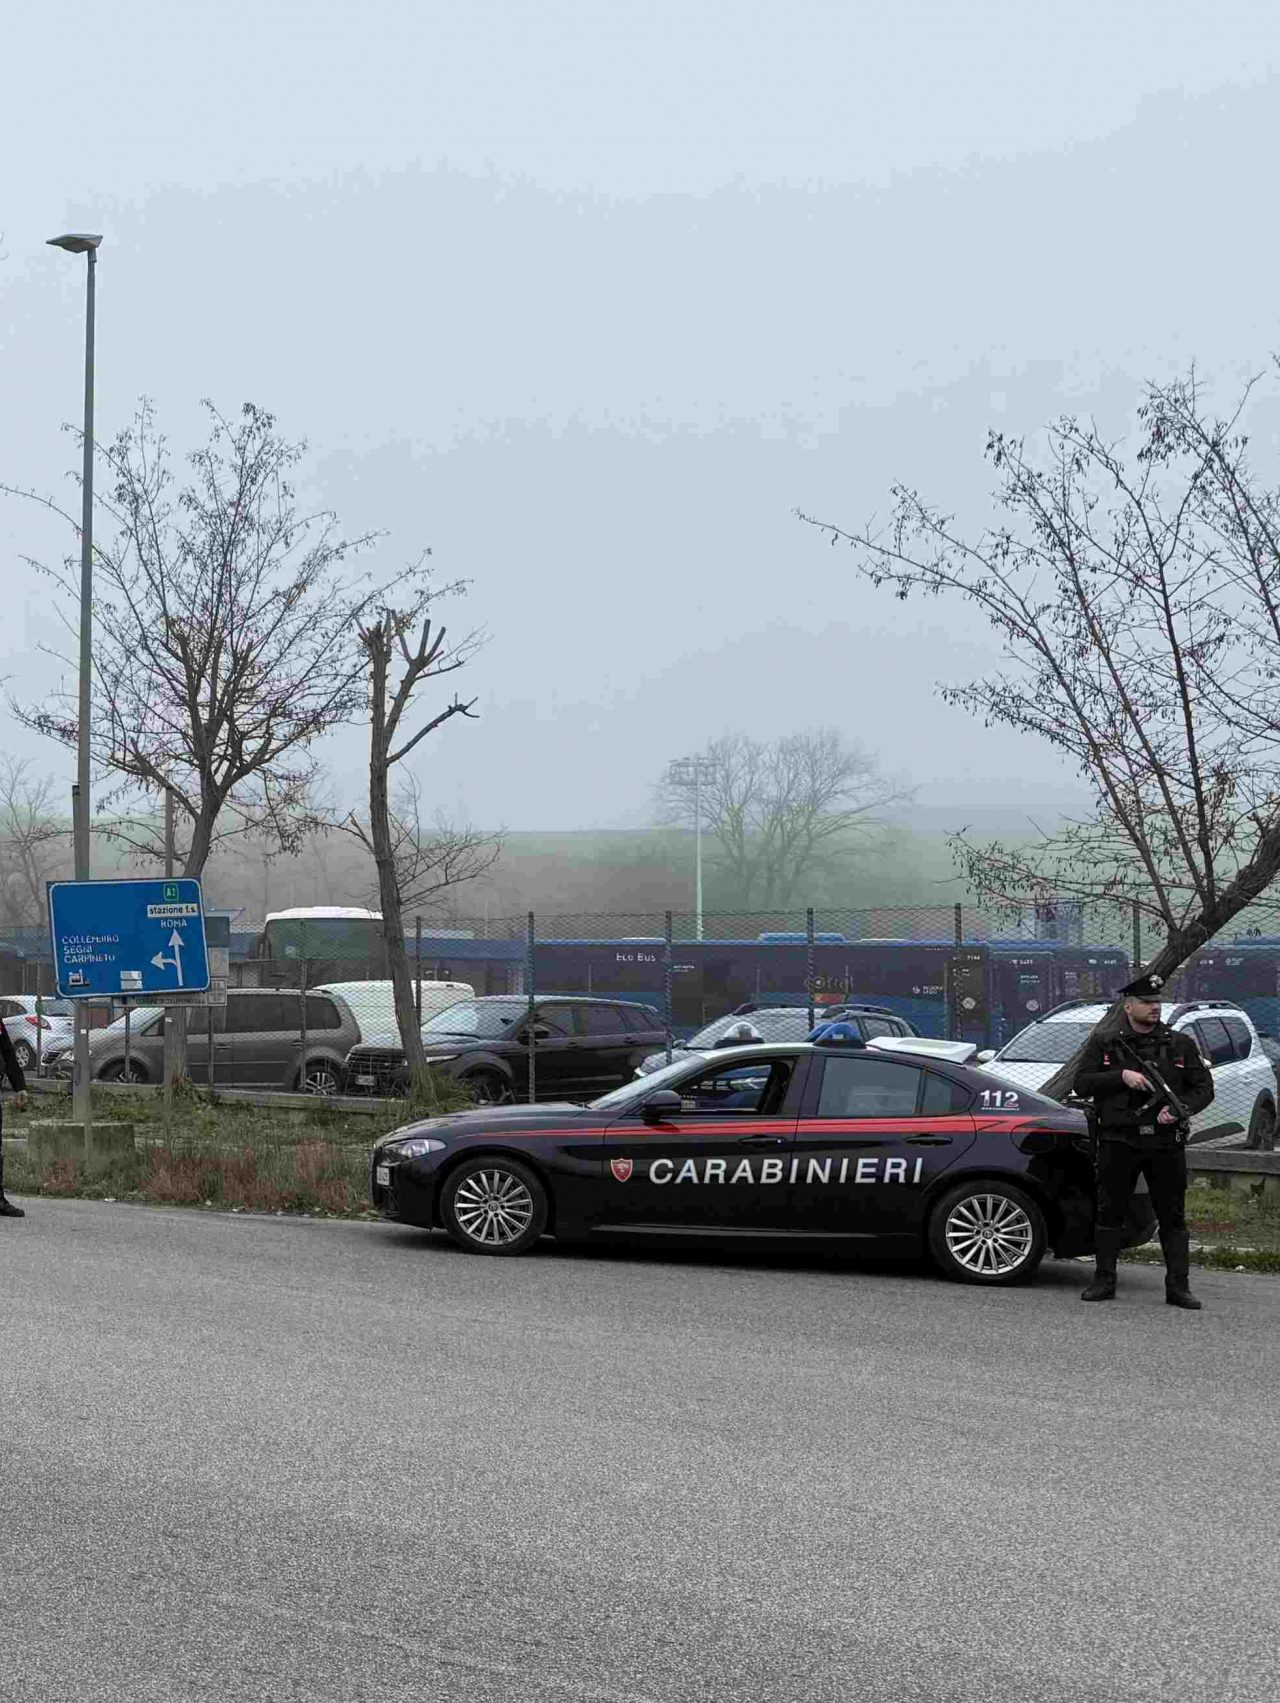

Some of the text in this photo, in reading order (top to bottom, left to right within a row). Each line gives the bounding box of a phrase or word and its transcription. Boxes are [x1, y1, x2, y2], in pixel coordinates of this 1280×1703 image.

[150, 905, 183, 915] stazione
[160, 919, 187, 928] ROMA
[63, 945, 93, 955] SEGNI
[64, 954, 116, 964] CARPINETO
[616, 953, 656, 962] Eco Bus
[980, 1090, 1019, 1107] 112
[649, 1157, 924, 1185] CARABINIERI
